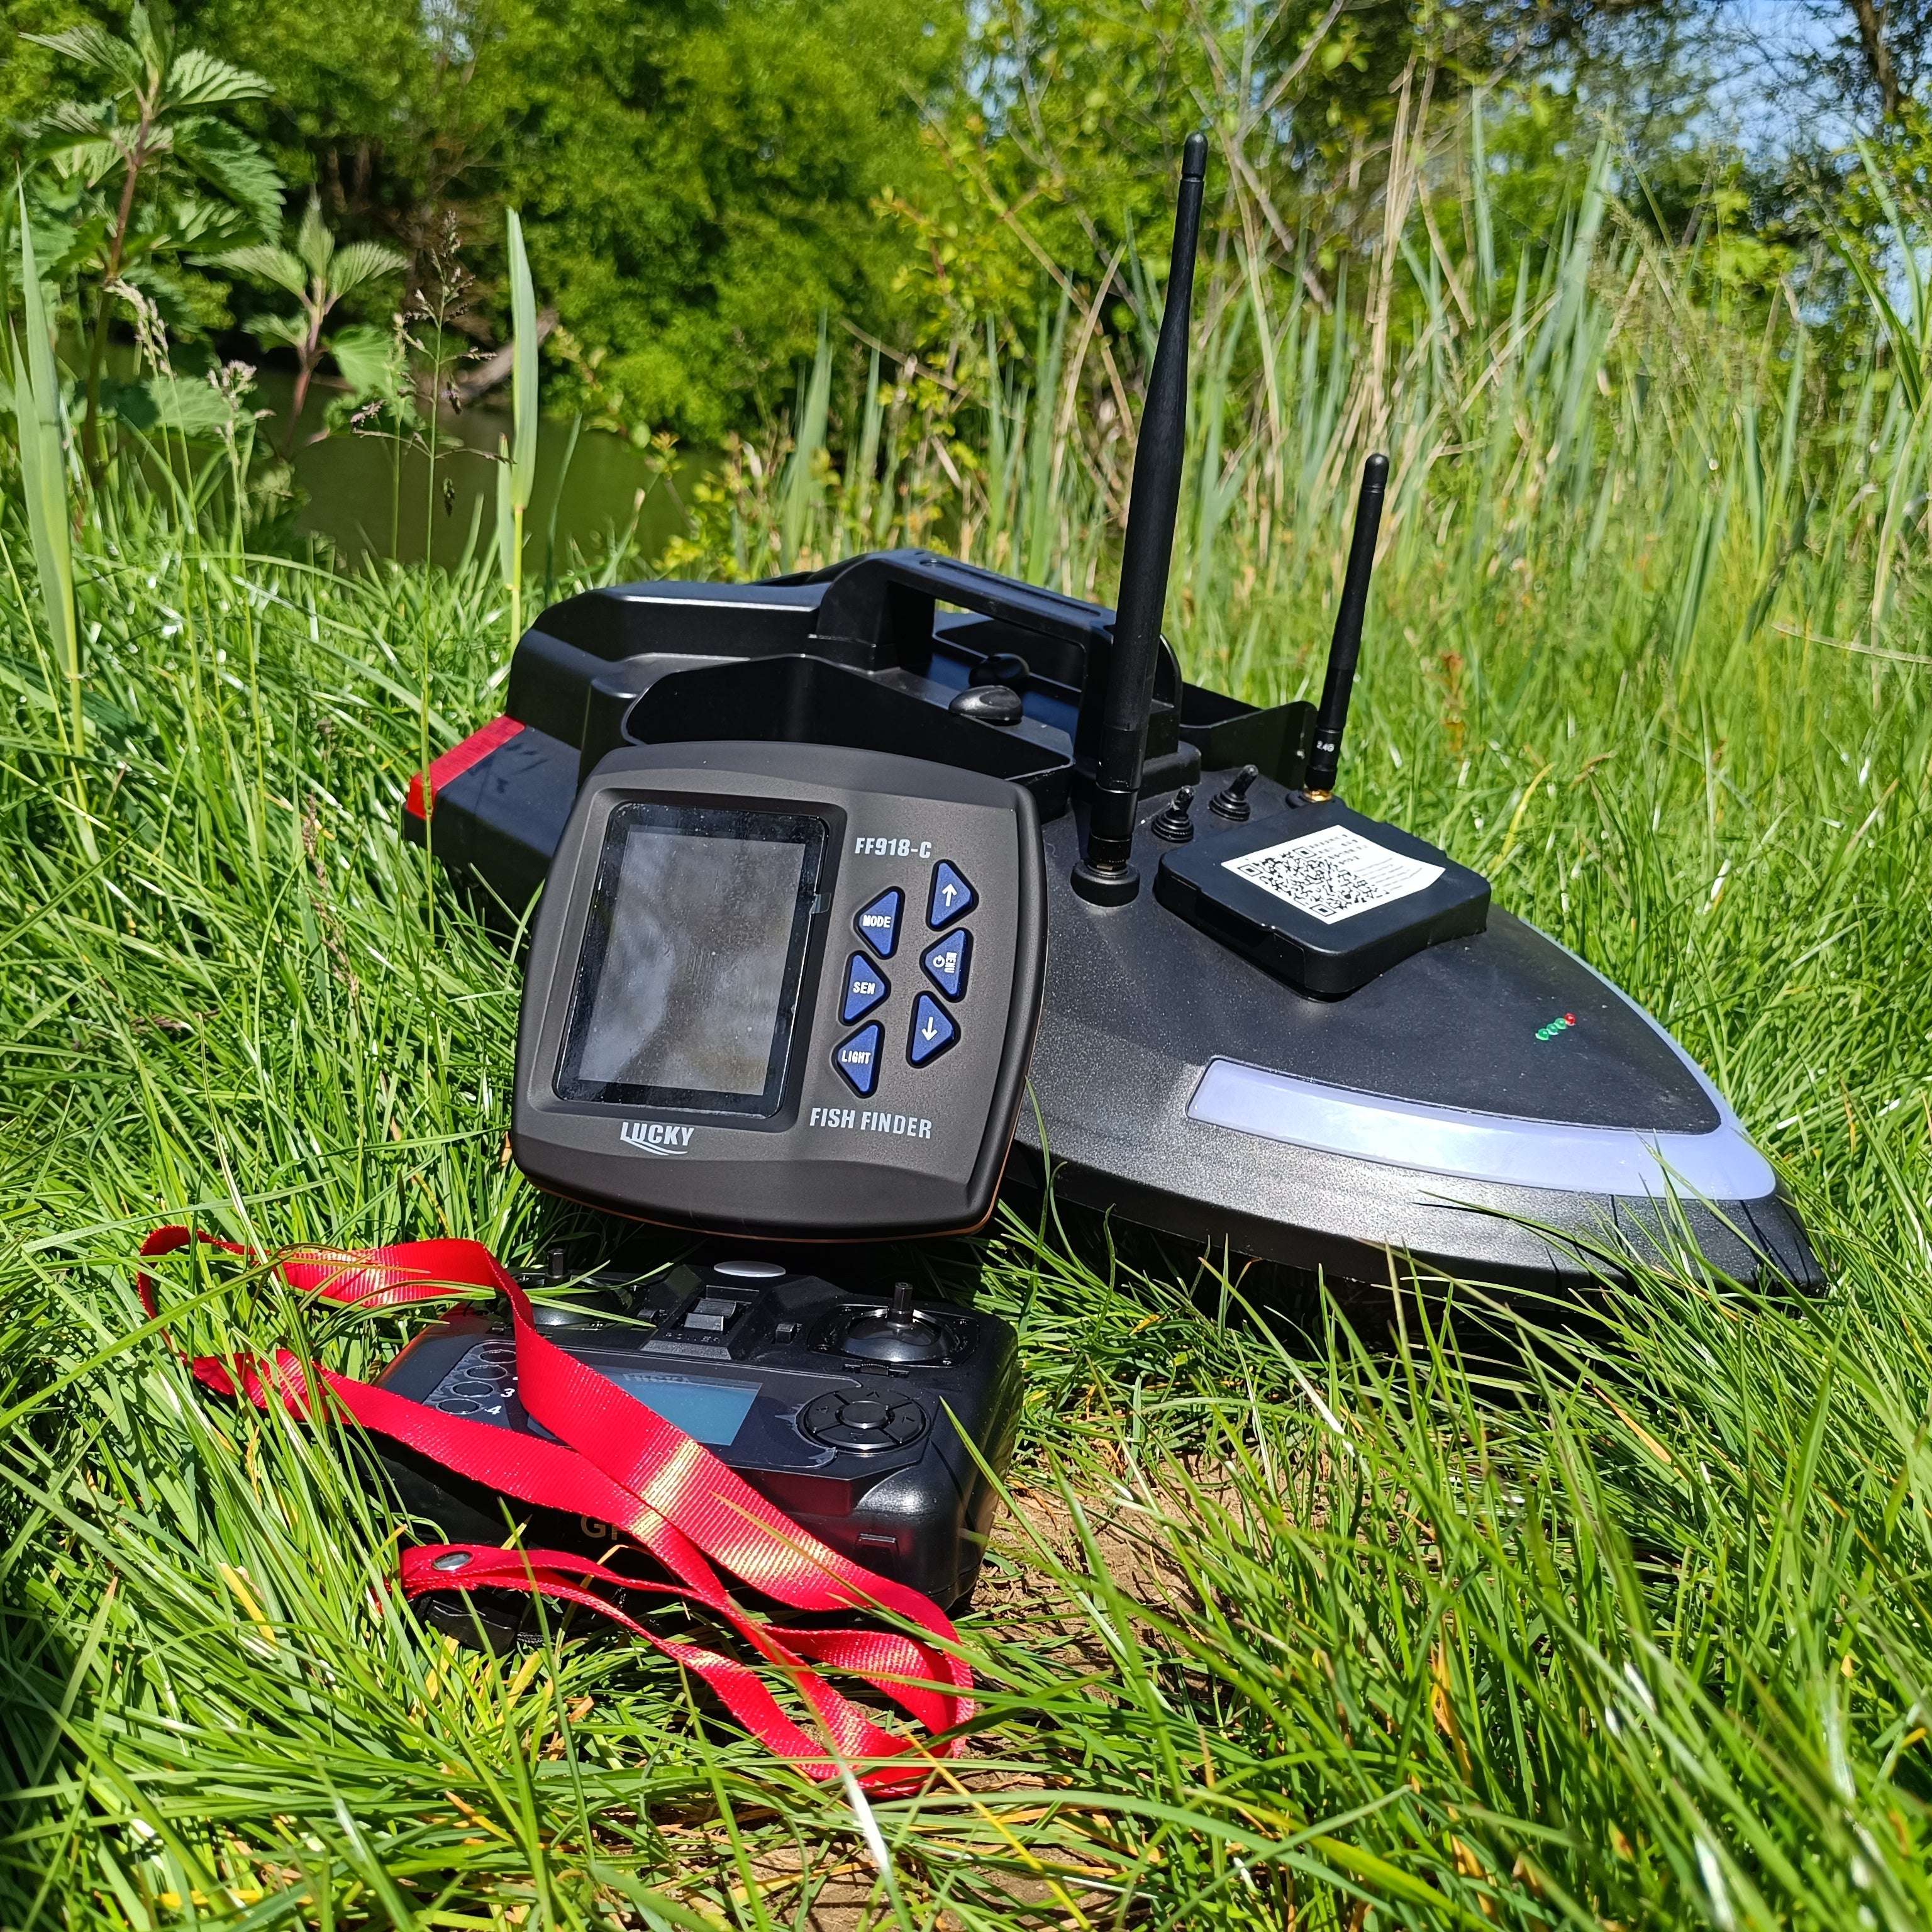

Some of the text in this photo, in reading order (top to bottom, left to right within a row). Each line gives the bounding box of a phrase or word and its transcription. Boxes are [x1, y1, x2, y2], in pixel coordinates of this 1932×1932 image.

[855, 837, 932, 858] FF918-C
[862, 914, 892, 928] MODE
[944, 952, 958, 974] MENU
[853, 981, 875, 995] SEN
[841, 1050, 872, 1065] LIGHT
[809, 1108, 932, 1139] FISH FINDER
[620, 1121, 695, 1146] LUCKY
[500, 1387, 516, 1397] 3
[484, 1405, 502, 1415] 4
